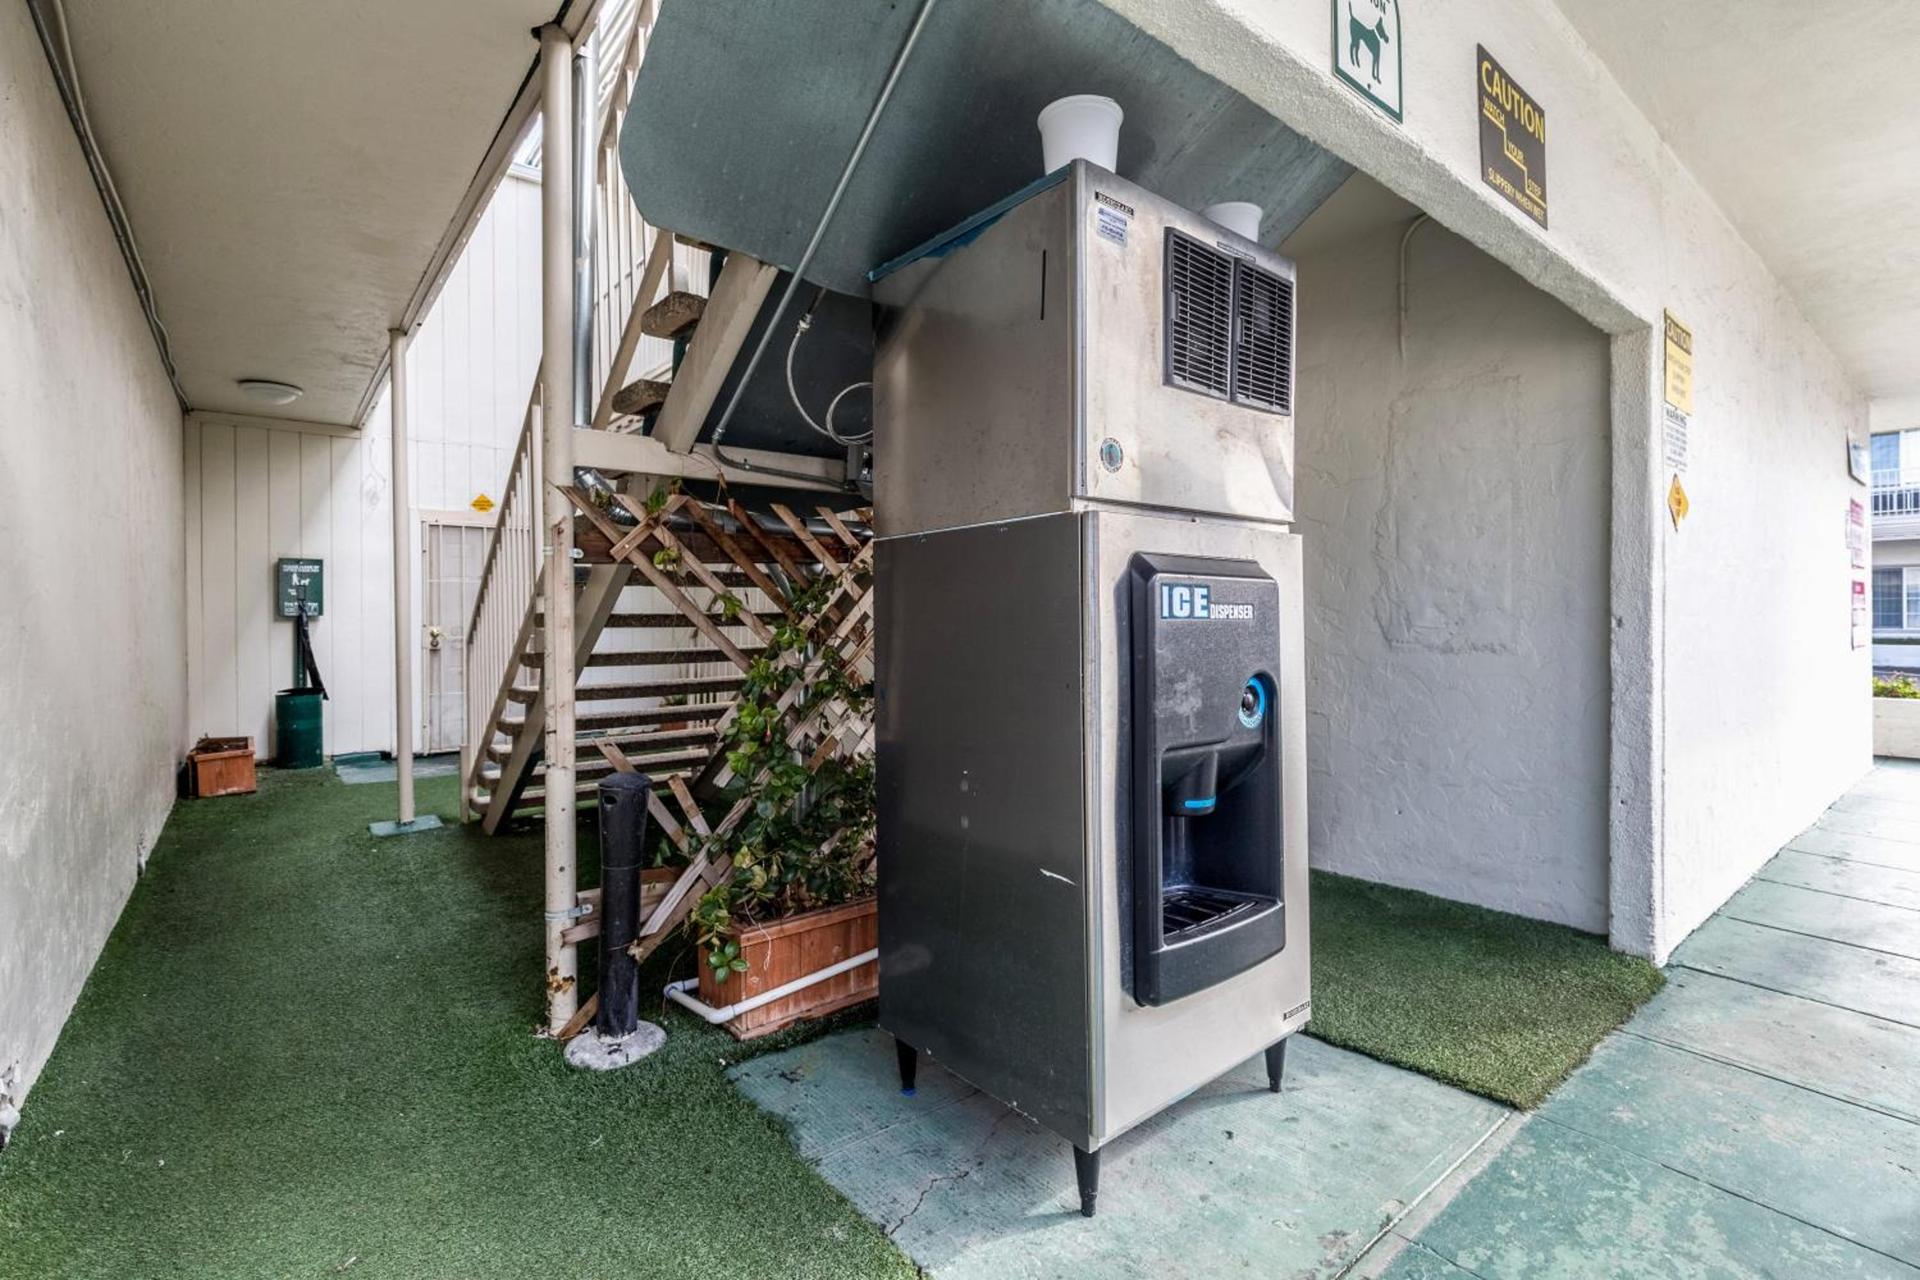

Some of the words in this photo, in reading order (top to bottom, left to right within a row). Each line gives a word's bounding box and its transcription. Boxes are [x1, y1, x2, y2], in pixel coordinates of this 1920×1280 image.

[1481, 60, 1545, 144] CAUTION
[1483, 95, 1504, 126] WATCH
[1507, 141, 1525, 164] YOUR
[1488, 167, 1515, 198] SLIPPERY
[1515, 190, 1533, 213] WHEN
[1528, 178, 1542, 198] STEP
[1162, 585, 1209, 618] ICE
[1209, 604, 1254, 619] DISPENSER
